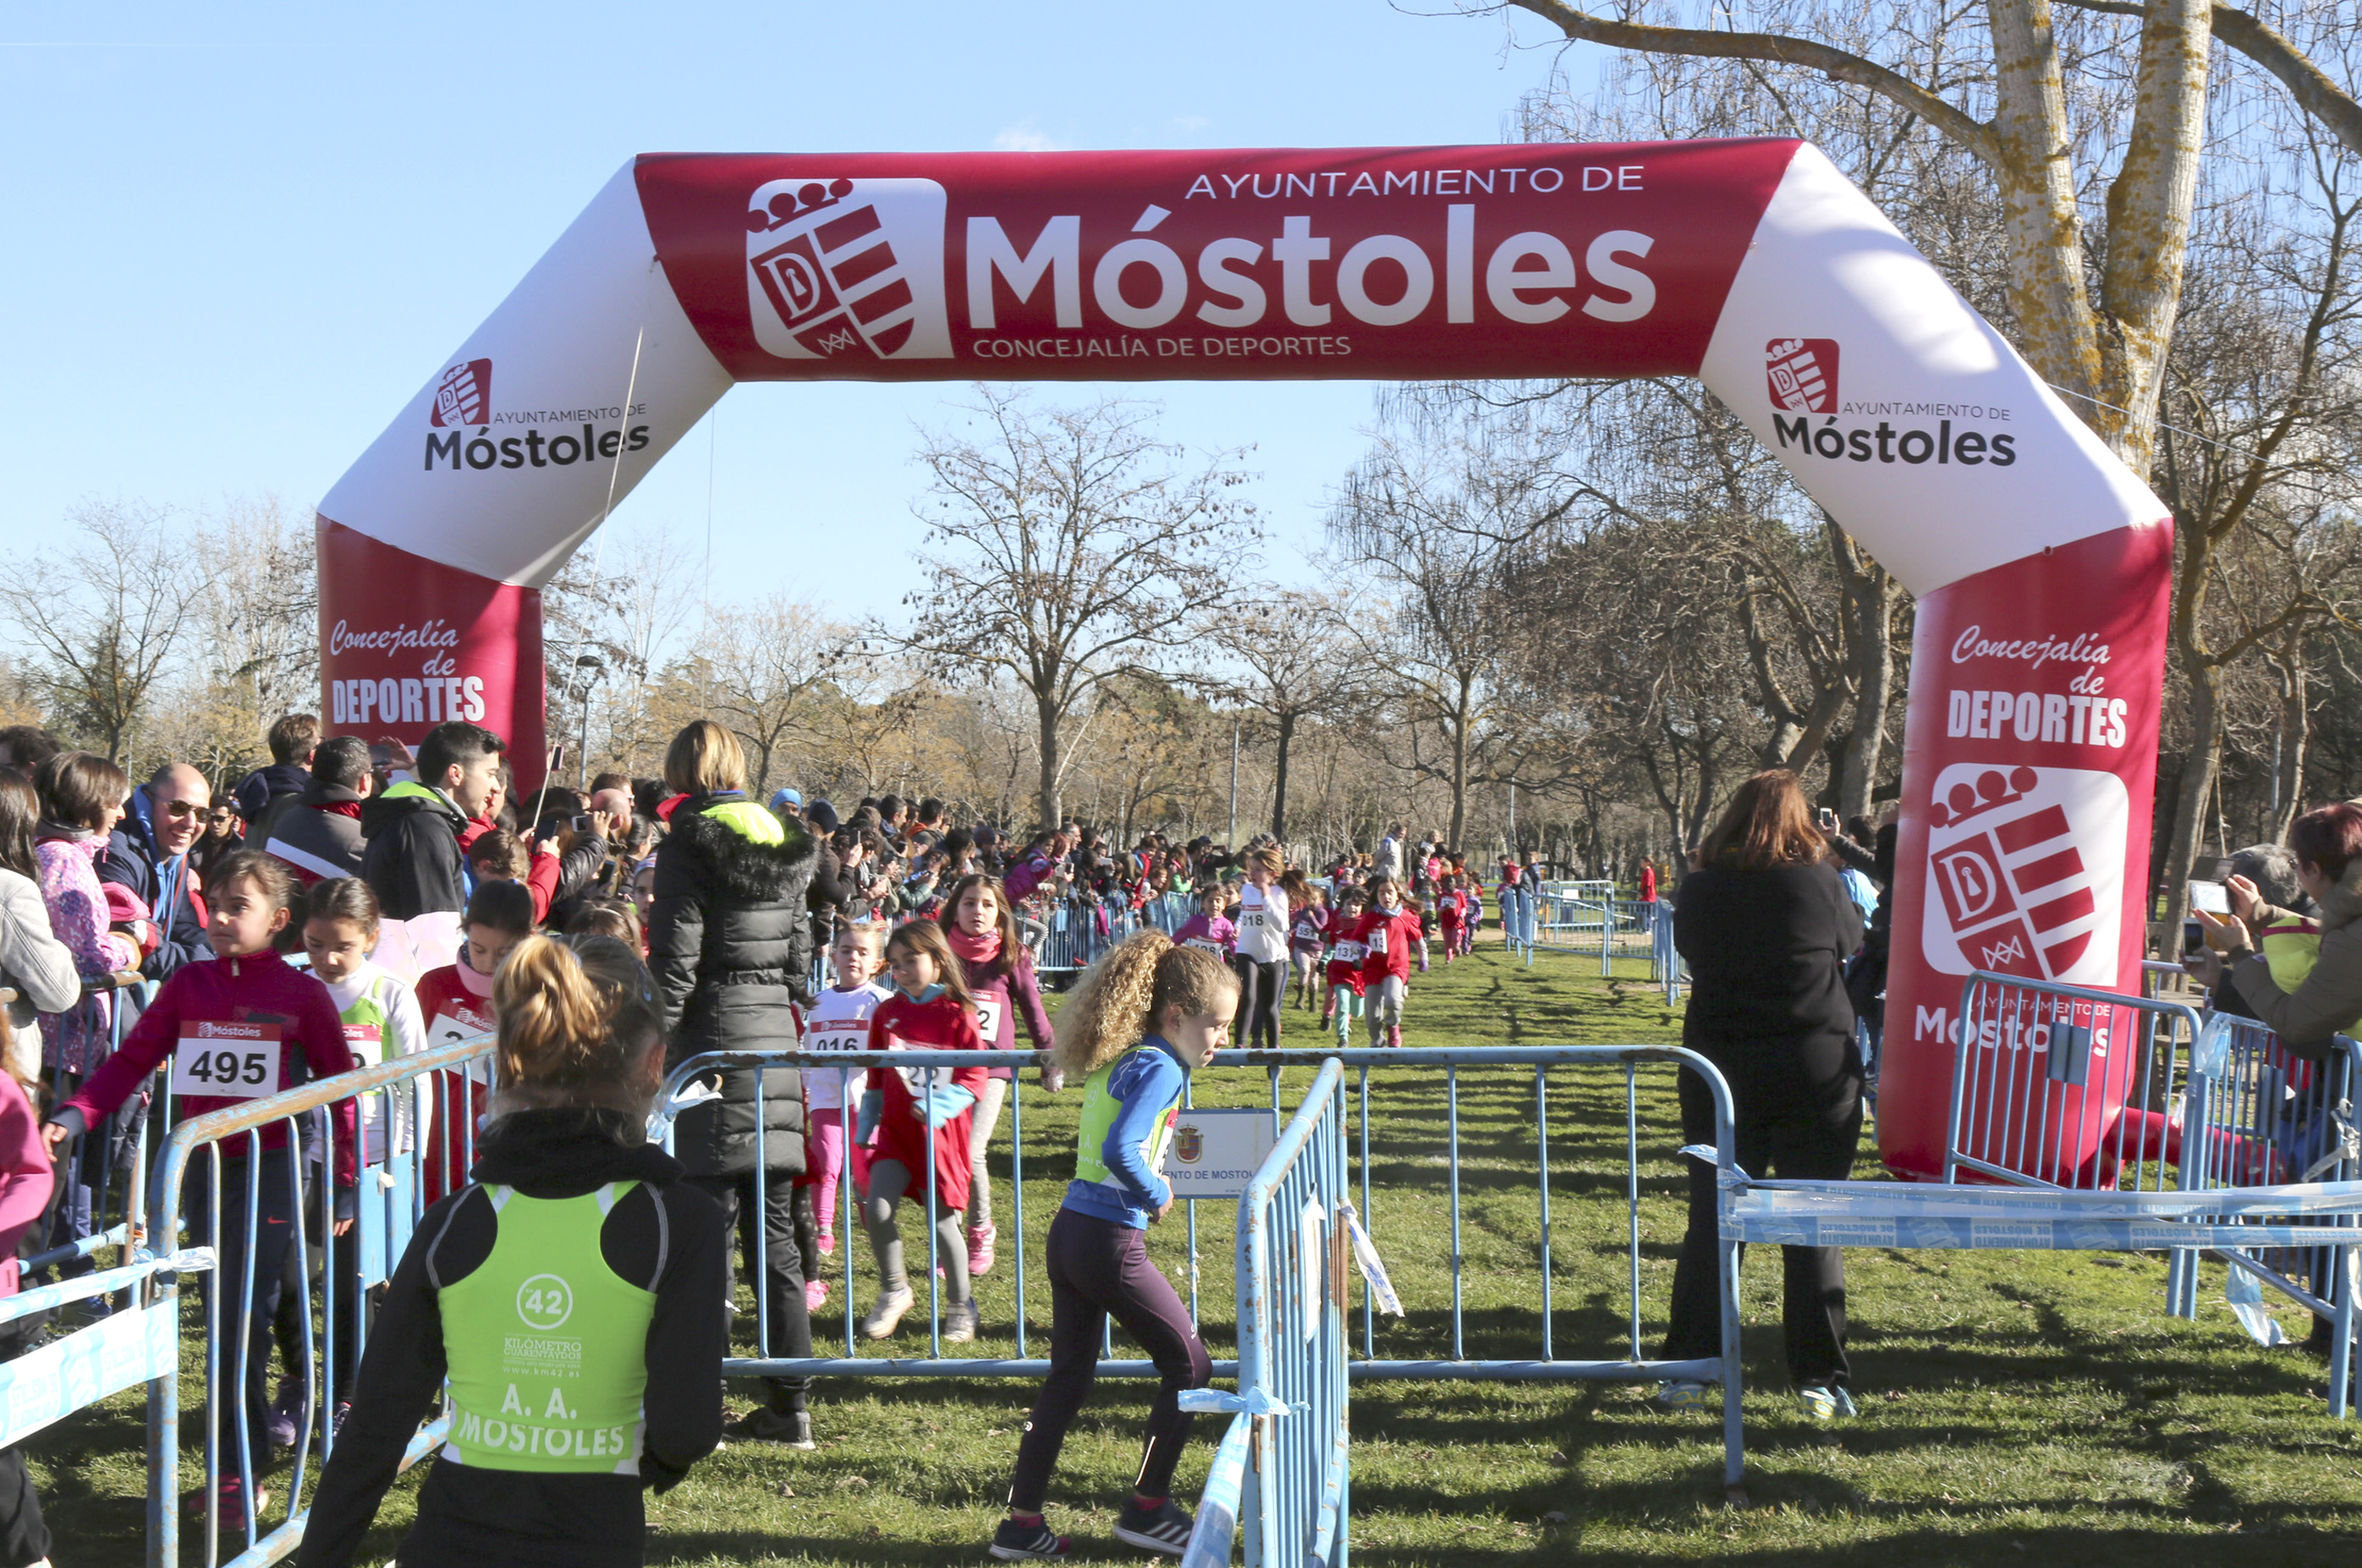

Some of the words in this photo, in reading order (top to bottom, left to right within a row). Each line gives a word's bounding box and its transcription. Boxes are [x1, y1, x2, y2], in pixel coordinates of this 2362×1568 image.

[1185, 168, 1564, 199] AYUNTAMIENTO
[1582, 165, 1644, 192] DE
[966, 204, 1656, 329] Móstoles
[973, 335, 1150, 358] CONCEJALÍA
[1158, 338, 1193, 357] DE
[1203, 336, 1352, 356] DEPORTES
[494, 406, 621, 424] AYUNTAMIENTO
[1842, 401, 1984, 419] AYUNTAMIENTO
[1989, 407, 2012, 422] DE
[424, 423, 650, 472] Móstoles
[1772, 412, 2016, 467] Móstoles
[330, 619, 459, 658] Concejalía
[1951, 624, 2111, 669] Concejalía
[423, 650, 456, 676] de
[2069, 665, 2105, 695] de
[332, 675, 485, 724] DEPORTES
[1947, 690, 2128, 748] DEPORTES
[1976, 997, 2092, 1016] AYUNTAMENTO
[188, 1050, 266, 1084] 495
[1163, 1170, 1191, 1179] ENTO
[1195, 1171, 1208, 1179] DE
[525, 1289, 563, 1314] 42
[504, 1336, 583, 1352] KILÓMETRO
[501, 1383, 532, 1417] A.
[544, 1387, 578, 1420] A.
[458, 1410, 624, 1457] MOSTOLES
